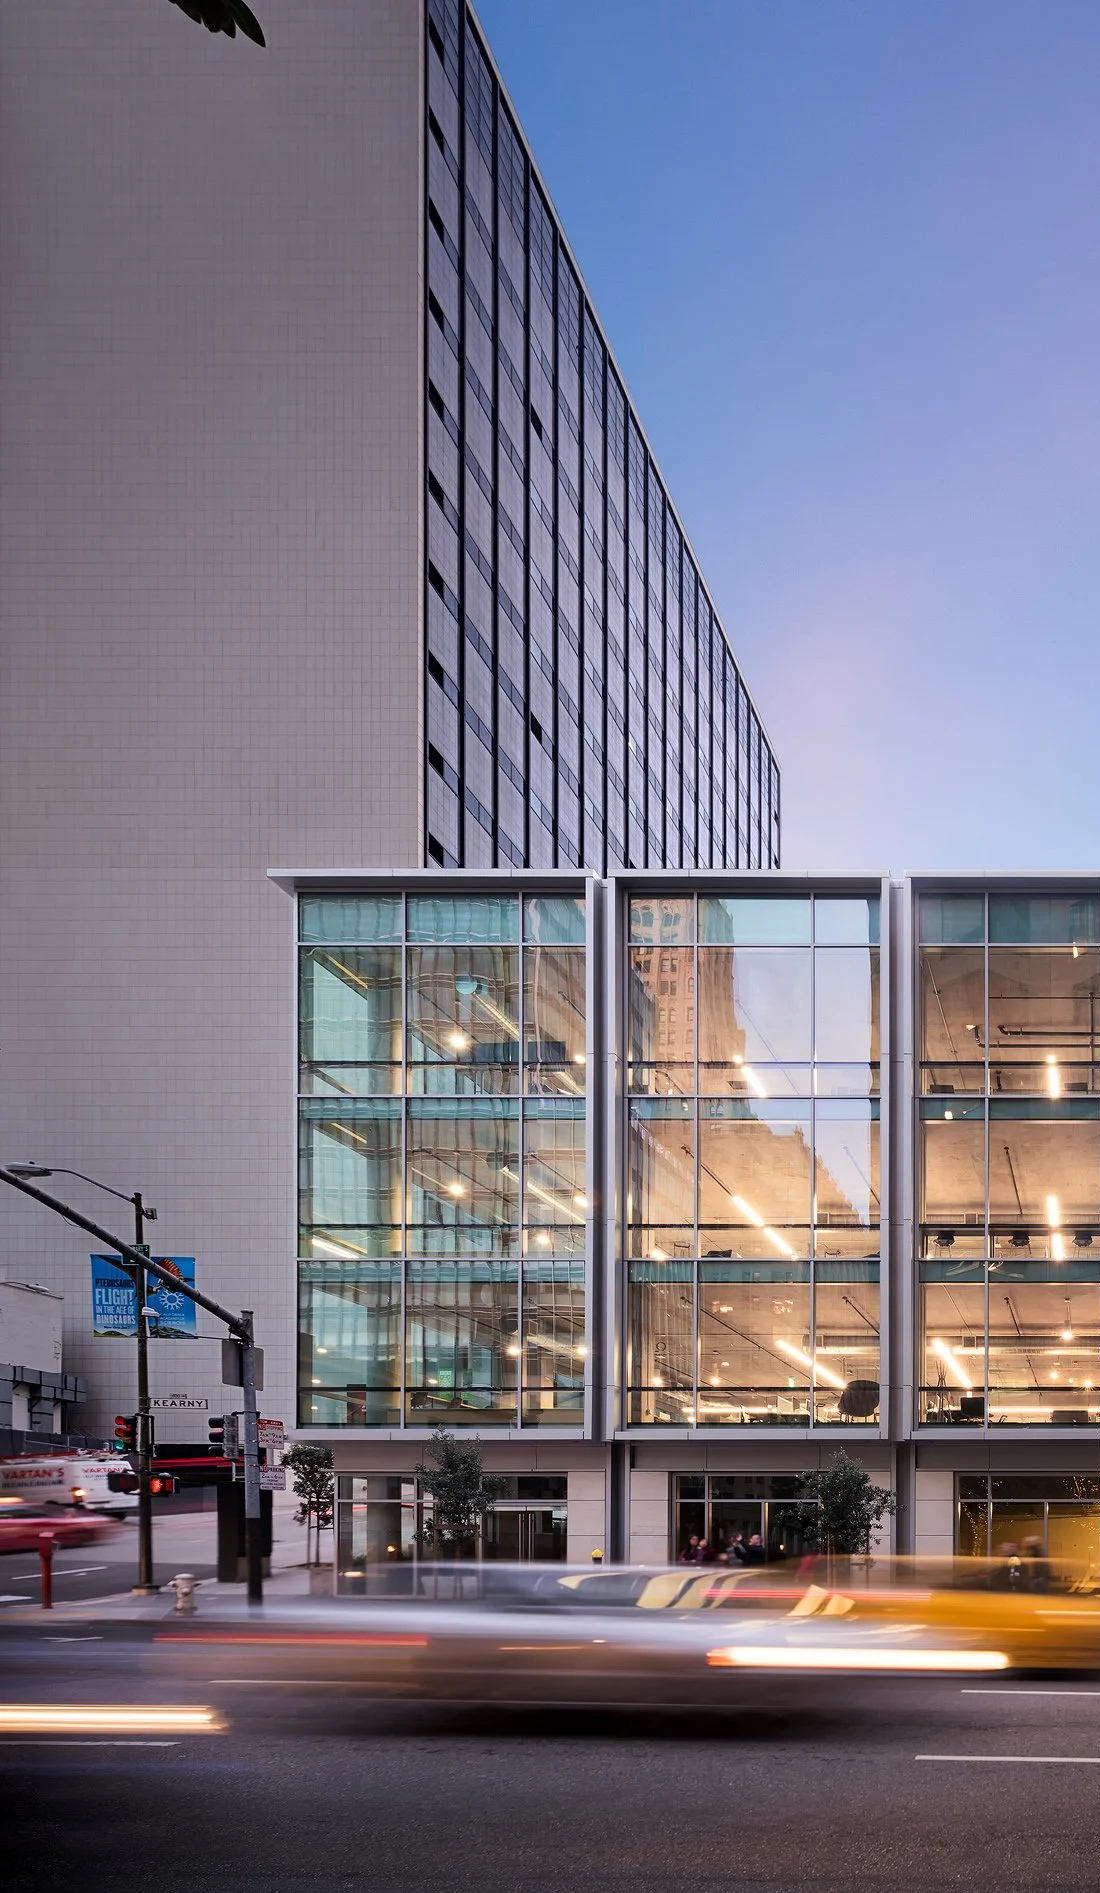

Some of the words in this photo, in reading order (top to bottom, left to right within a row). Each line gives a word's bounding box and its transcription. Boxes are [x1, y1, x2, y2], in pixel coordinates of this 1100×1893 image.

[95, 1288, 135, 1305] FLIGHT
[95, 1305, 103, 1313] IN
[103, 1305, 115, 1314] THE
[115, 1306, 127, 1314] AGE
[127, 1306, 134, 1314] OF
[96, 1314, 136, 1324] DINOSAURS
[153, 1399, 203, 1407] KEARNY
[2, 1467, 65, 1480] VARTAN'S
